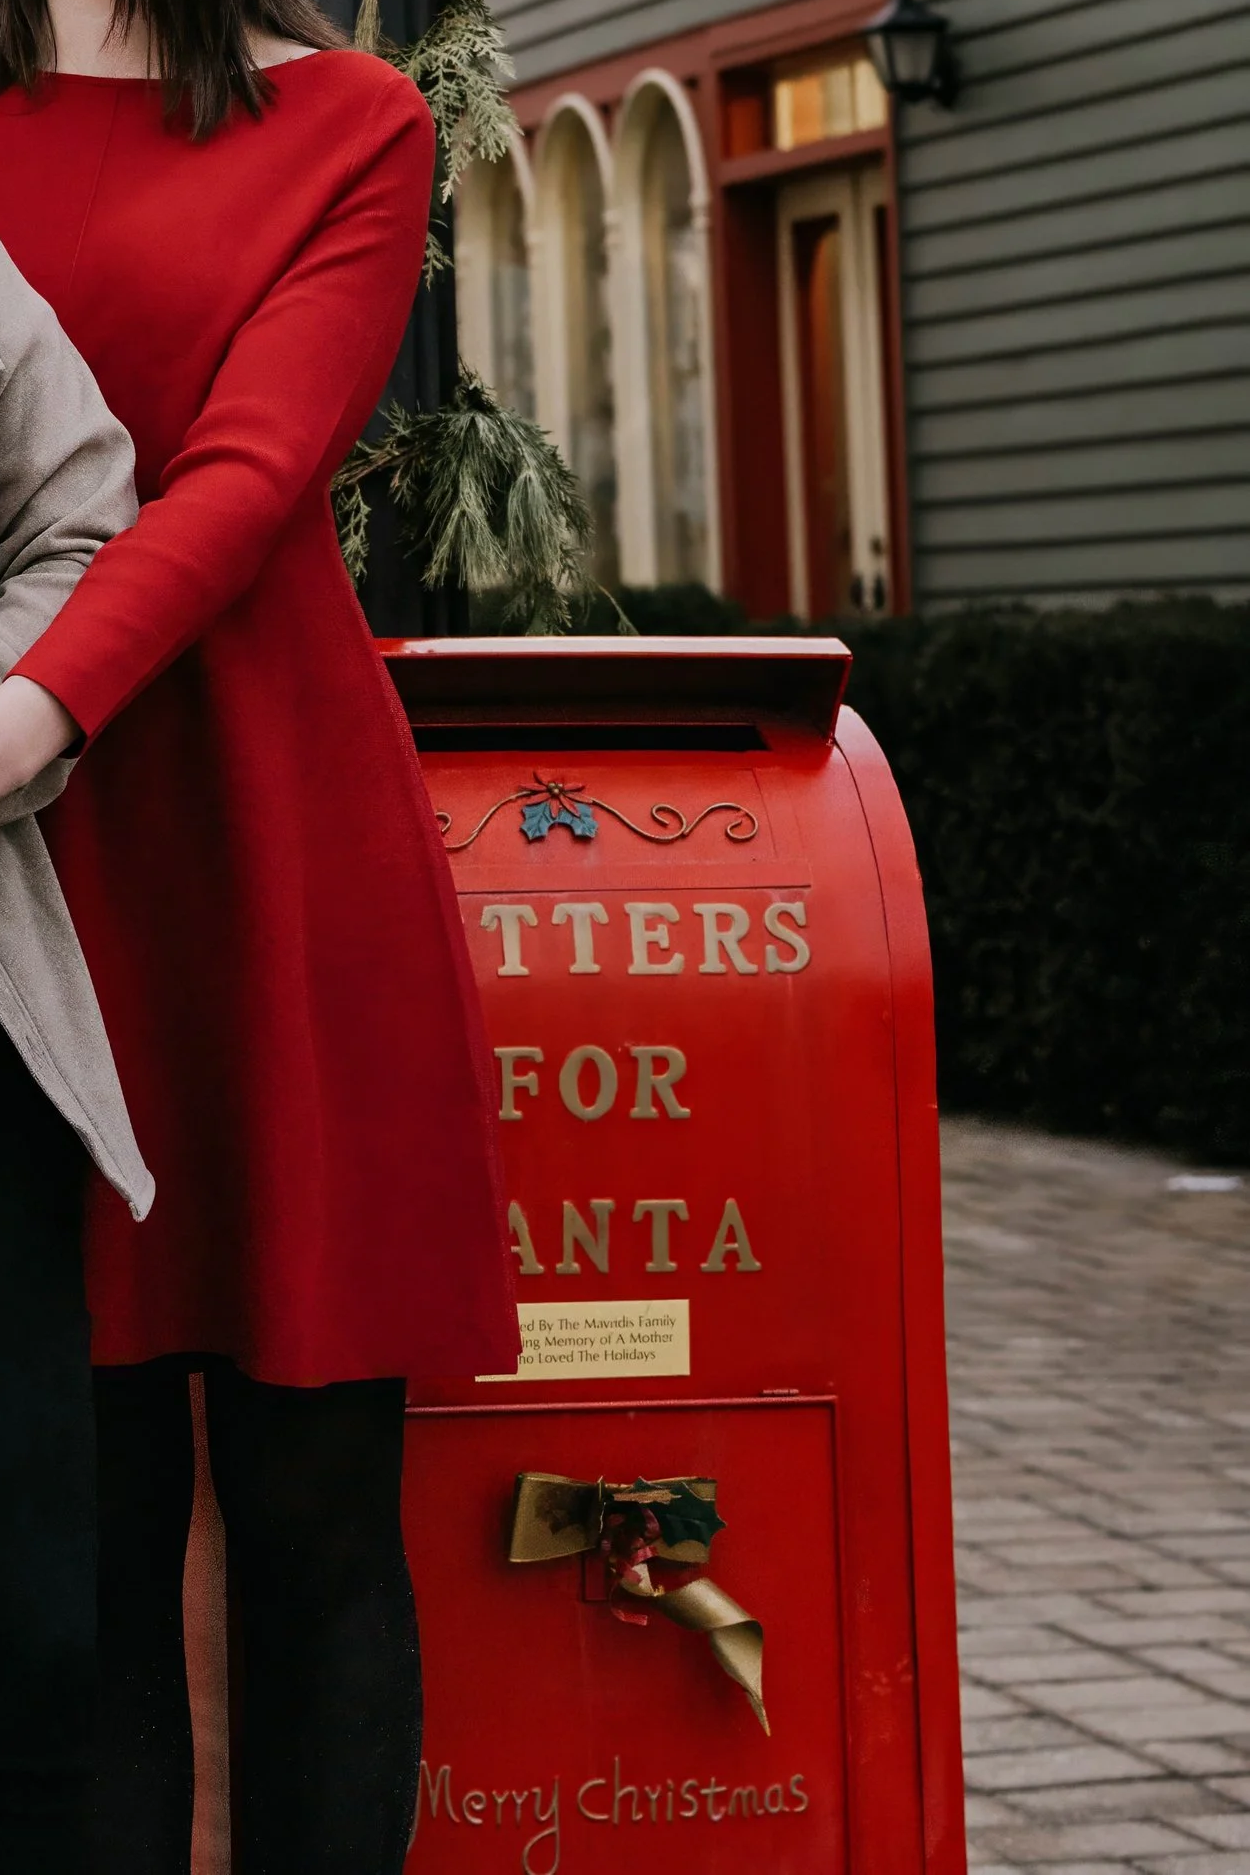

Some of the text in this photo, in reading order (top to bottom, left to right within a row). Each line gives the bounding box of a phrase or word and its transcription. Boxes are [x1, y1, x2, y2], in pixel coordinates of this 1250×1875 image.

[479, 900, 812, 977] TTERS
[493, 1044, 692, 1121] FOR
[506, 1197, 763, 1276] ANTA
[538, 1319, 554, 1333] By
[558, 1318, 580, 1331] The
[638, 1313, 677, 1329] Family
[538, 1351, 574, 1364] Loved
[578, 1349, 600, 1363] The
[604, 1348, 657, 1362] Holidays
[544, 1335, 595, 1350] Memory
[599, 1333, 612, 1346] of
[615, 1334, 626, 1345] A
[629, 1331, 674, 1344] Mother
[406, 1759, 560, 1875] Merry
